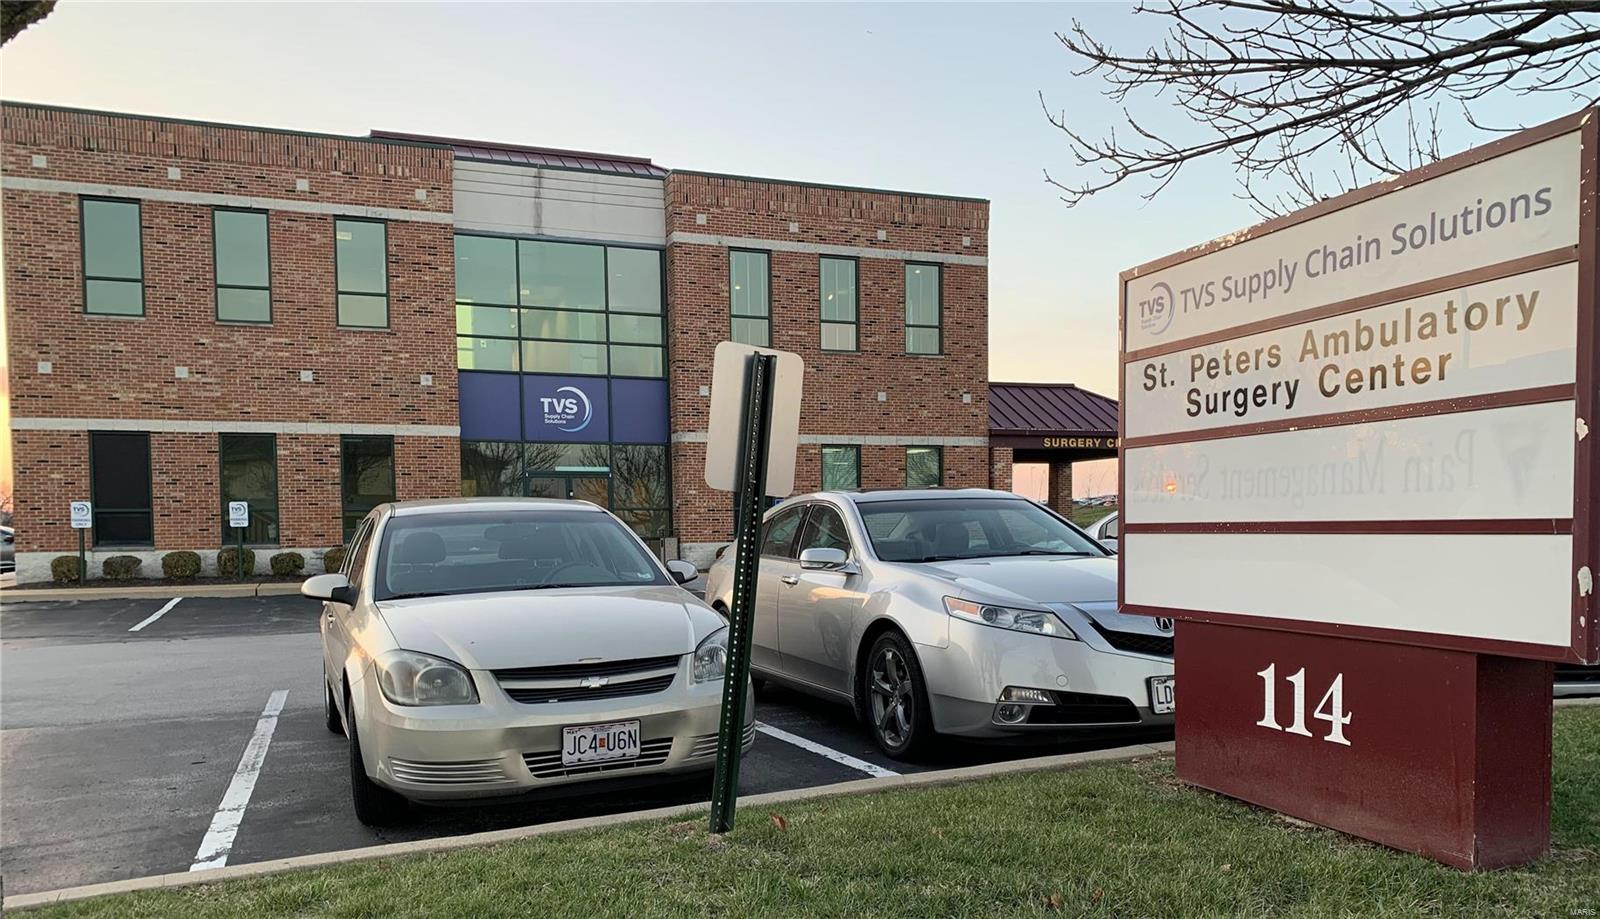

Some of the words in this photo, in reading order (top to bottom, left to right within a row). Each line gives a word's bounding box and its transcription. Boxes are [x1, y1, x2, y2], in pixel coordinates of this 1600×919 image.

[1180, 281, 1215, 313] TVS
[1222, 258, 1298, 303] Supply
[1305, 235, 1381, 278] Chain
[1391, 187, 1552, 255] Solutions
[1139, 296, 1165, 318] TVS
[1143, 363, 1175, 391] St.
[1191, 344, 1281, 382] Peters
[1299, 290, 1540, 363] Ambulatory
[540, 398, 578, 414] TVS
[1186, 379, 1300, 417] Surgery
[1318, 353, 1452, 398] Center
[1044, 437, 1101, 447] SURGERY
[1156, 685, 1175, 704] LD
[1256, 662, 1352, 746] 114
